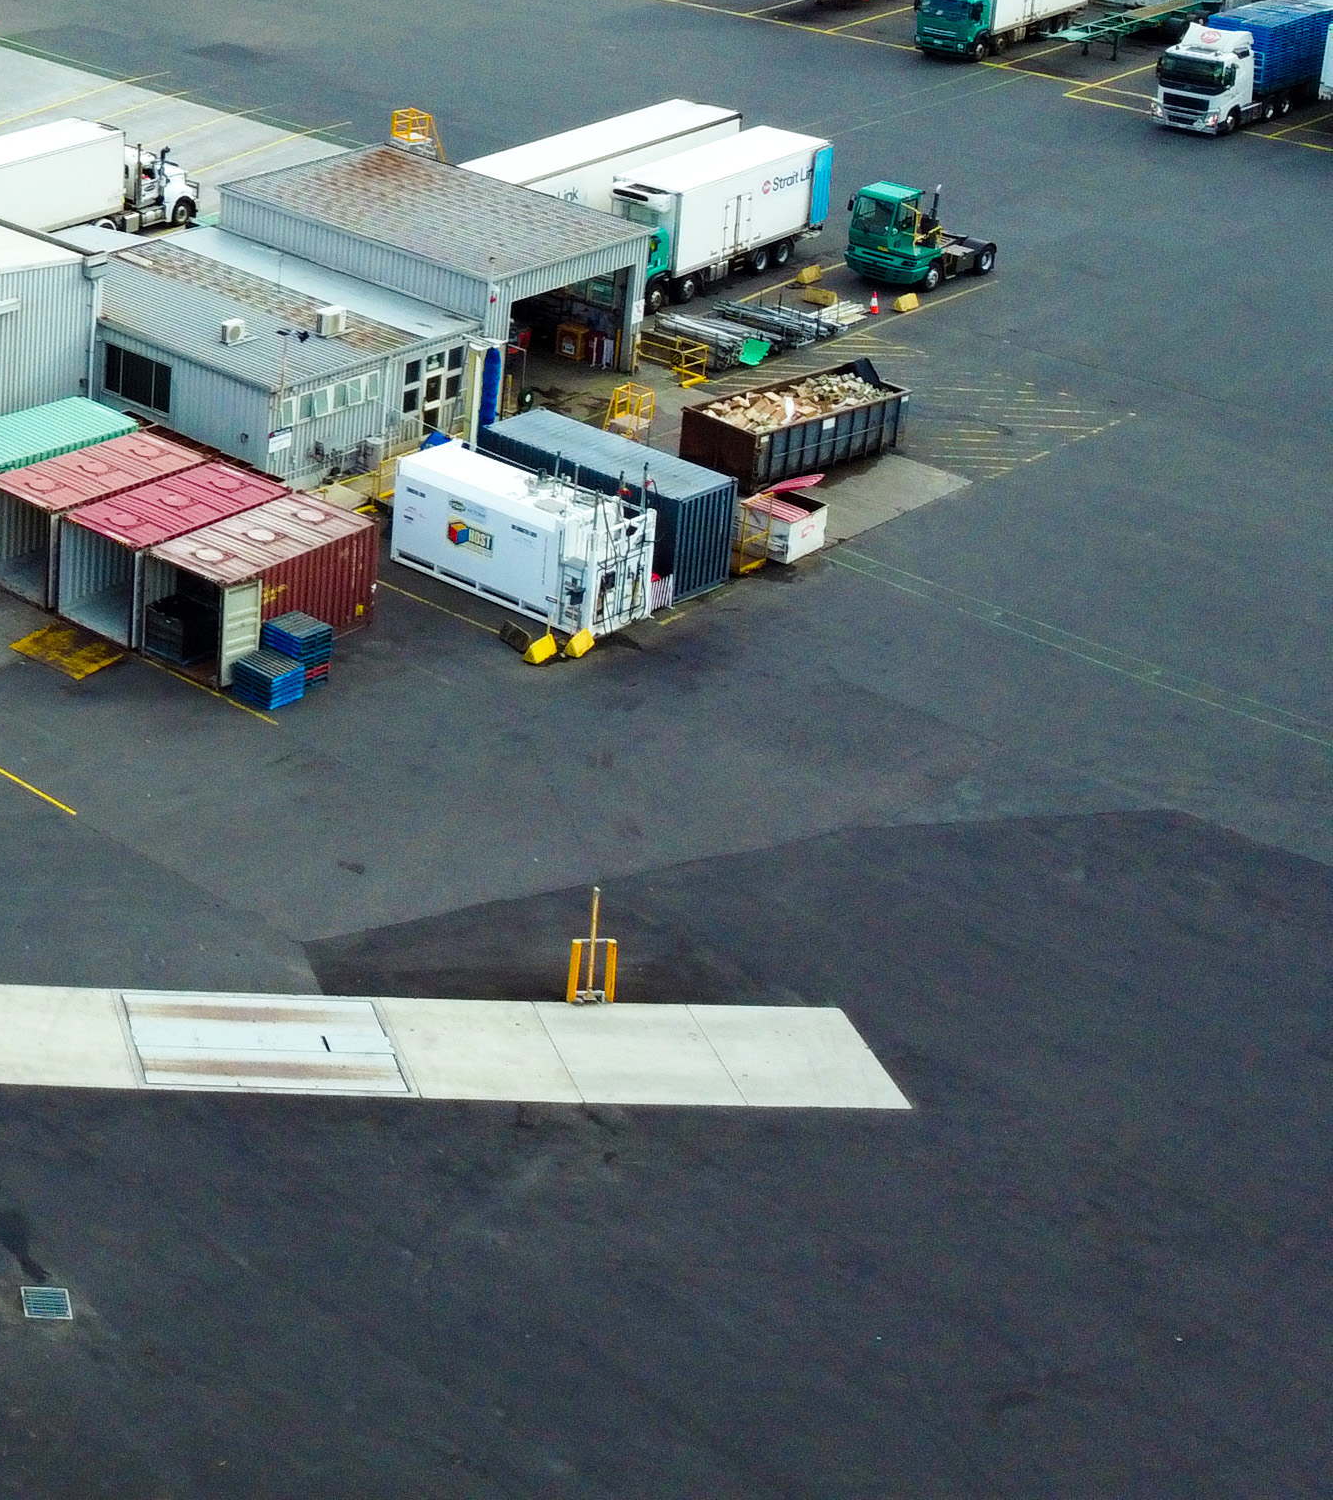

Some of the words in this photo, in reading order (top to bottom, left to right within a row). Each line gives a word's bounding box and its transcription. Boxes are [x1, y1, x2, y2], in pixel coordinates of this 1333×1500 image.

[773, 171, 798, 192] Strait
[800, 165, 814, 183] Lin
[469, 528, 491, 550] HOST
